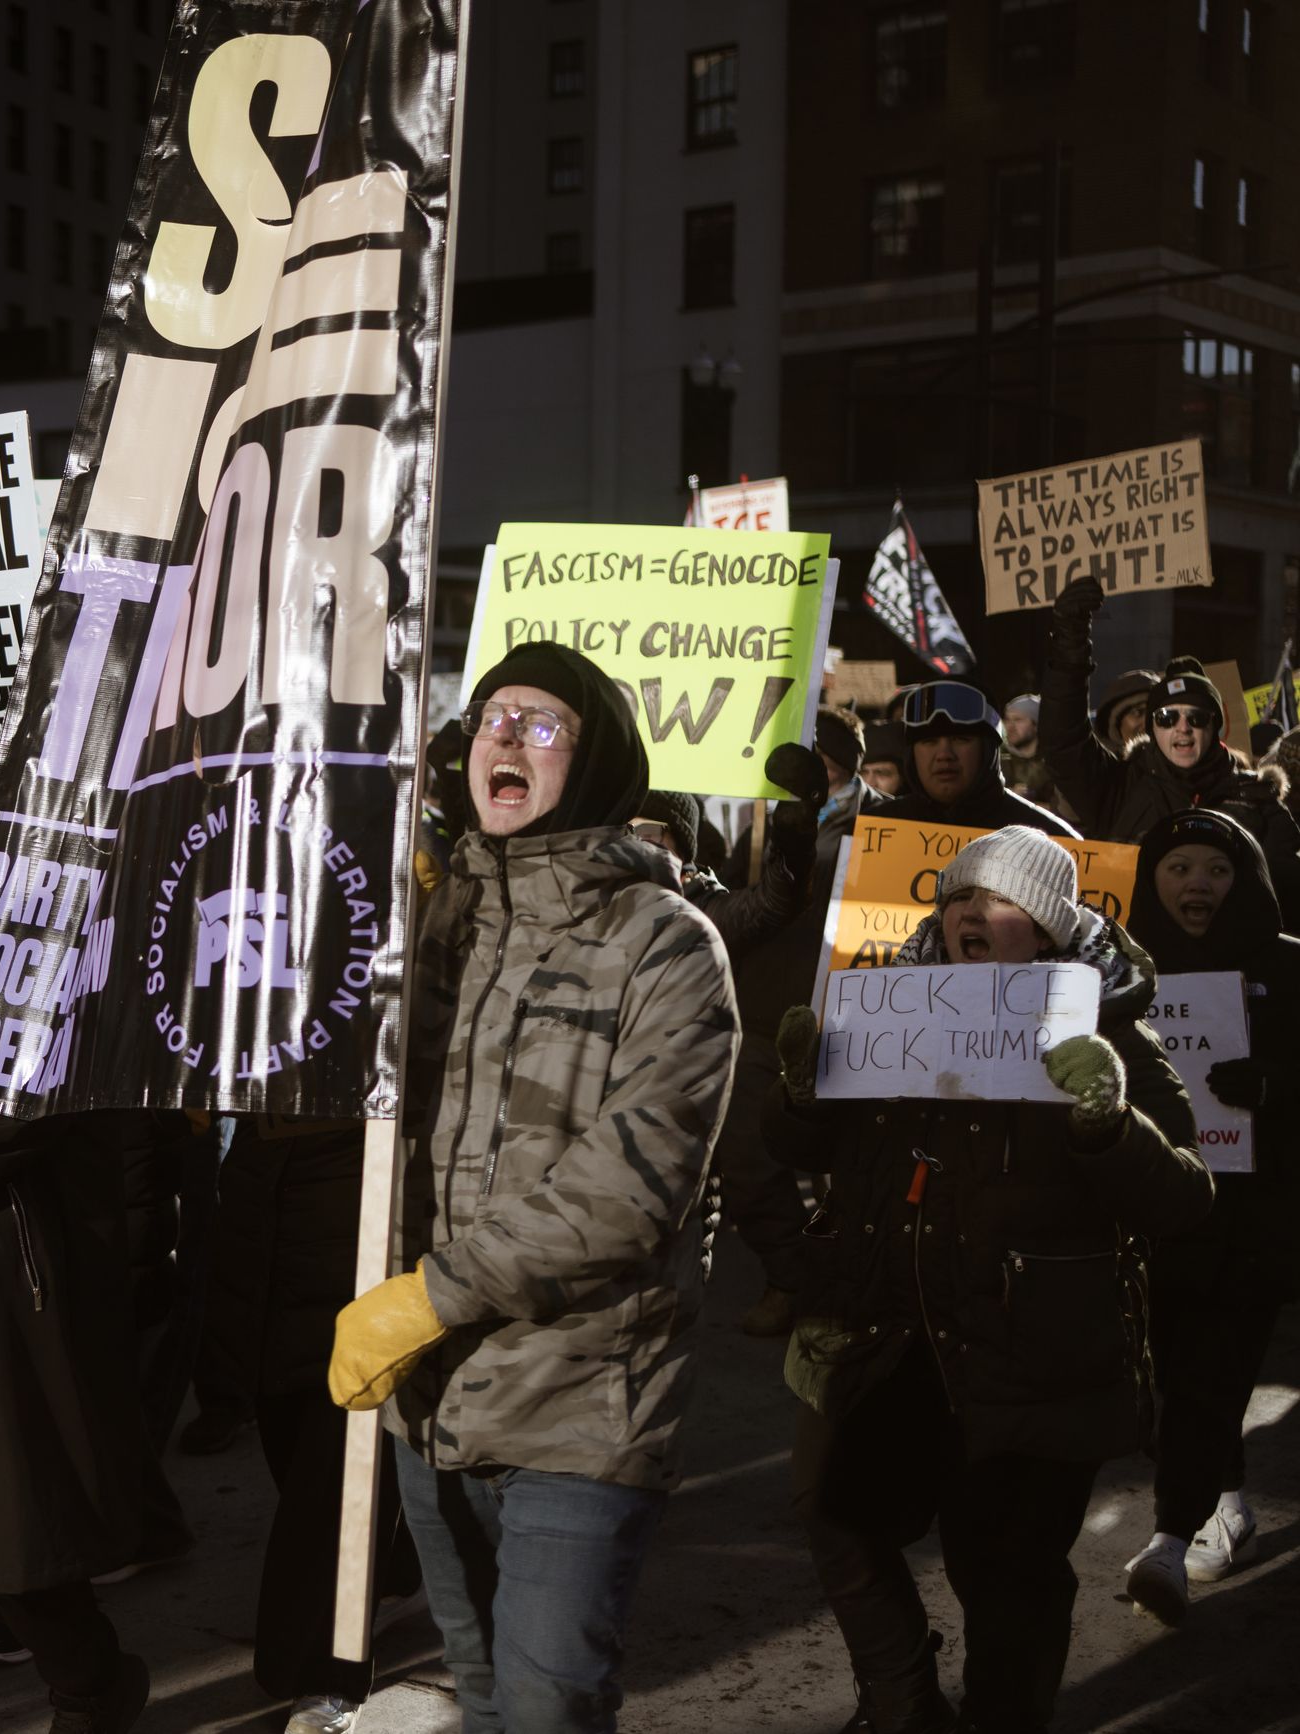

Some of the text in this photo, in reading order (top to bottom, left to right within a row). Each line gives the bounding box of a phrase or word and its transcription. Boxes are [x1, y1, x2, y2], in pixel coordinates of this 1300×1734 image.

[993, 448, 1184, 508] THE TIME IS
[993, 472, 1200, 544] ALWAYS RIGHT
[994, 510, 1195, 571] TO DO WHAT IS
[504, 615, 795, 662] POLICY CHANGE
[247, 798, 262, 826] &
[861, 826, 897, 854] IF
[146, 804, 229, 996] SOCIALISM
[274, 802, 379, 1020] LBERATION
[860, 906, 909, 935] YOU
[194, 917, 298, 989] PSL
[837, 968, 1074, 1016] FUCK ICE
[1146, 1002, 1190, 1019] ORE
[155, 1002, 205, 1069] FOR
[824, 1025, 1052, 1077] FUCK TRUMP
[1164, 1035, 1212, 1051] OTA
